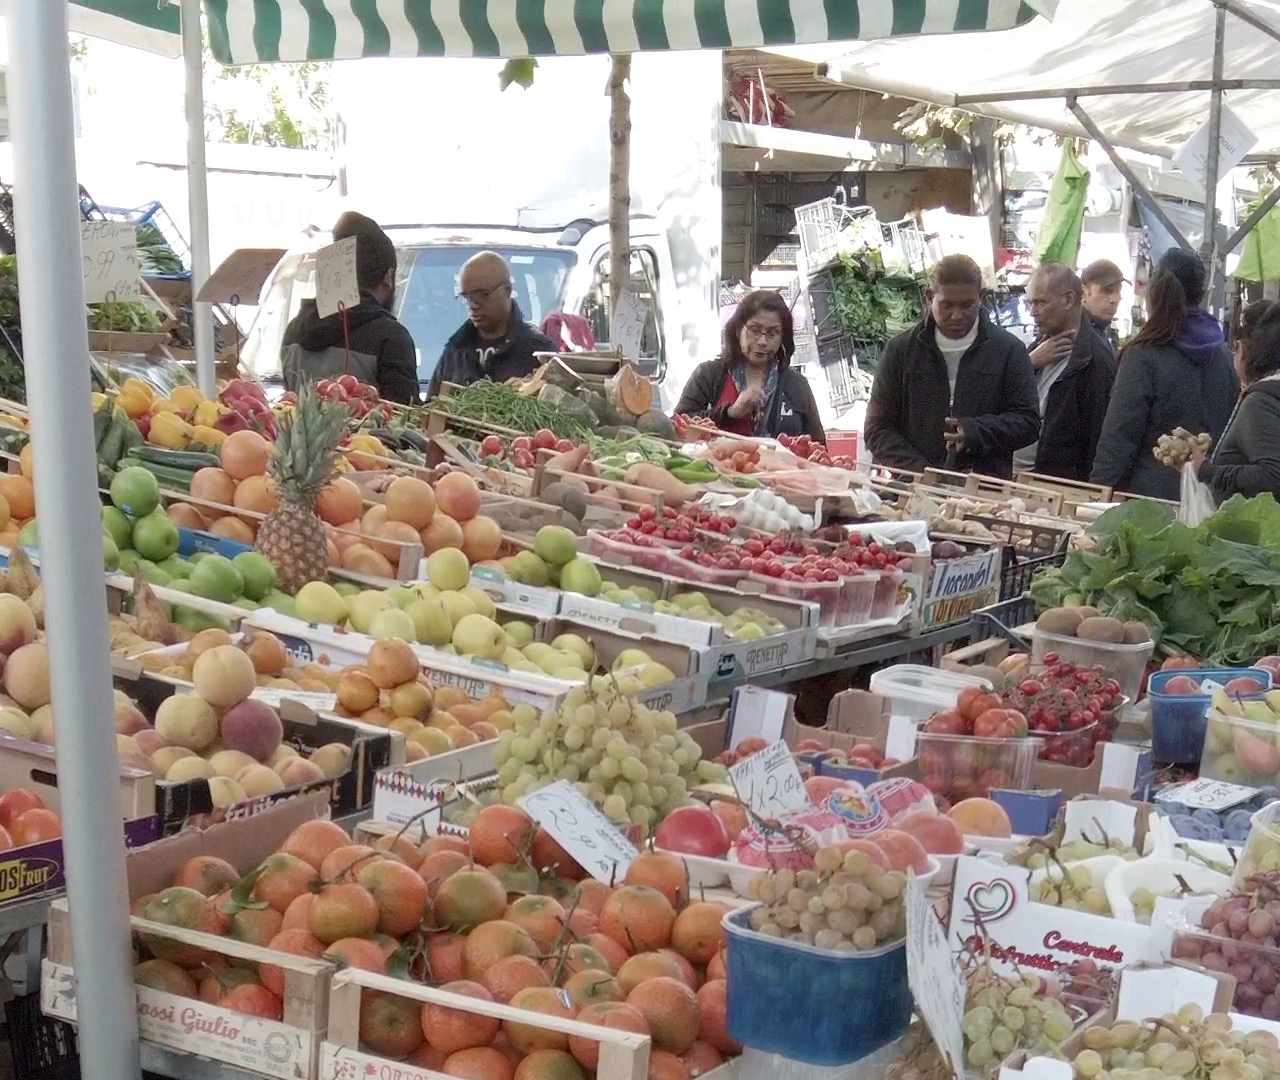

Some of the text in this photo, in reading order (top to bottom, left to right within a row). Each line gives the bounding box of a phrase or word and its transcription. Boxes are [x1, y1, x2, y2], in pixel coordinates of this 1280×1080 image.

[422, 667, 484, 697] RENETTA
[1043, 930, 1124, 964] Centrale
[181, 1007, 241, 1040] Giulio
